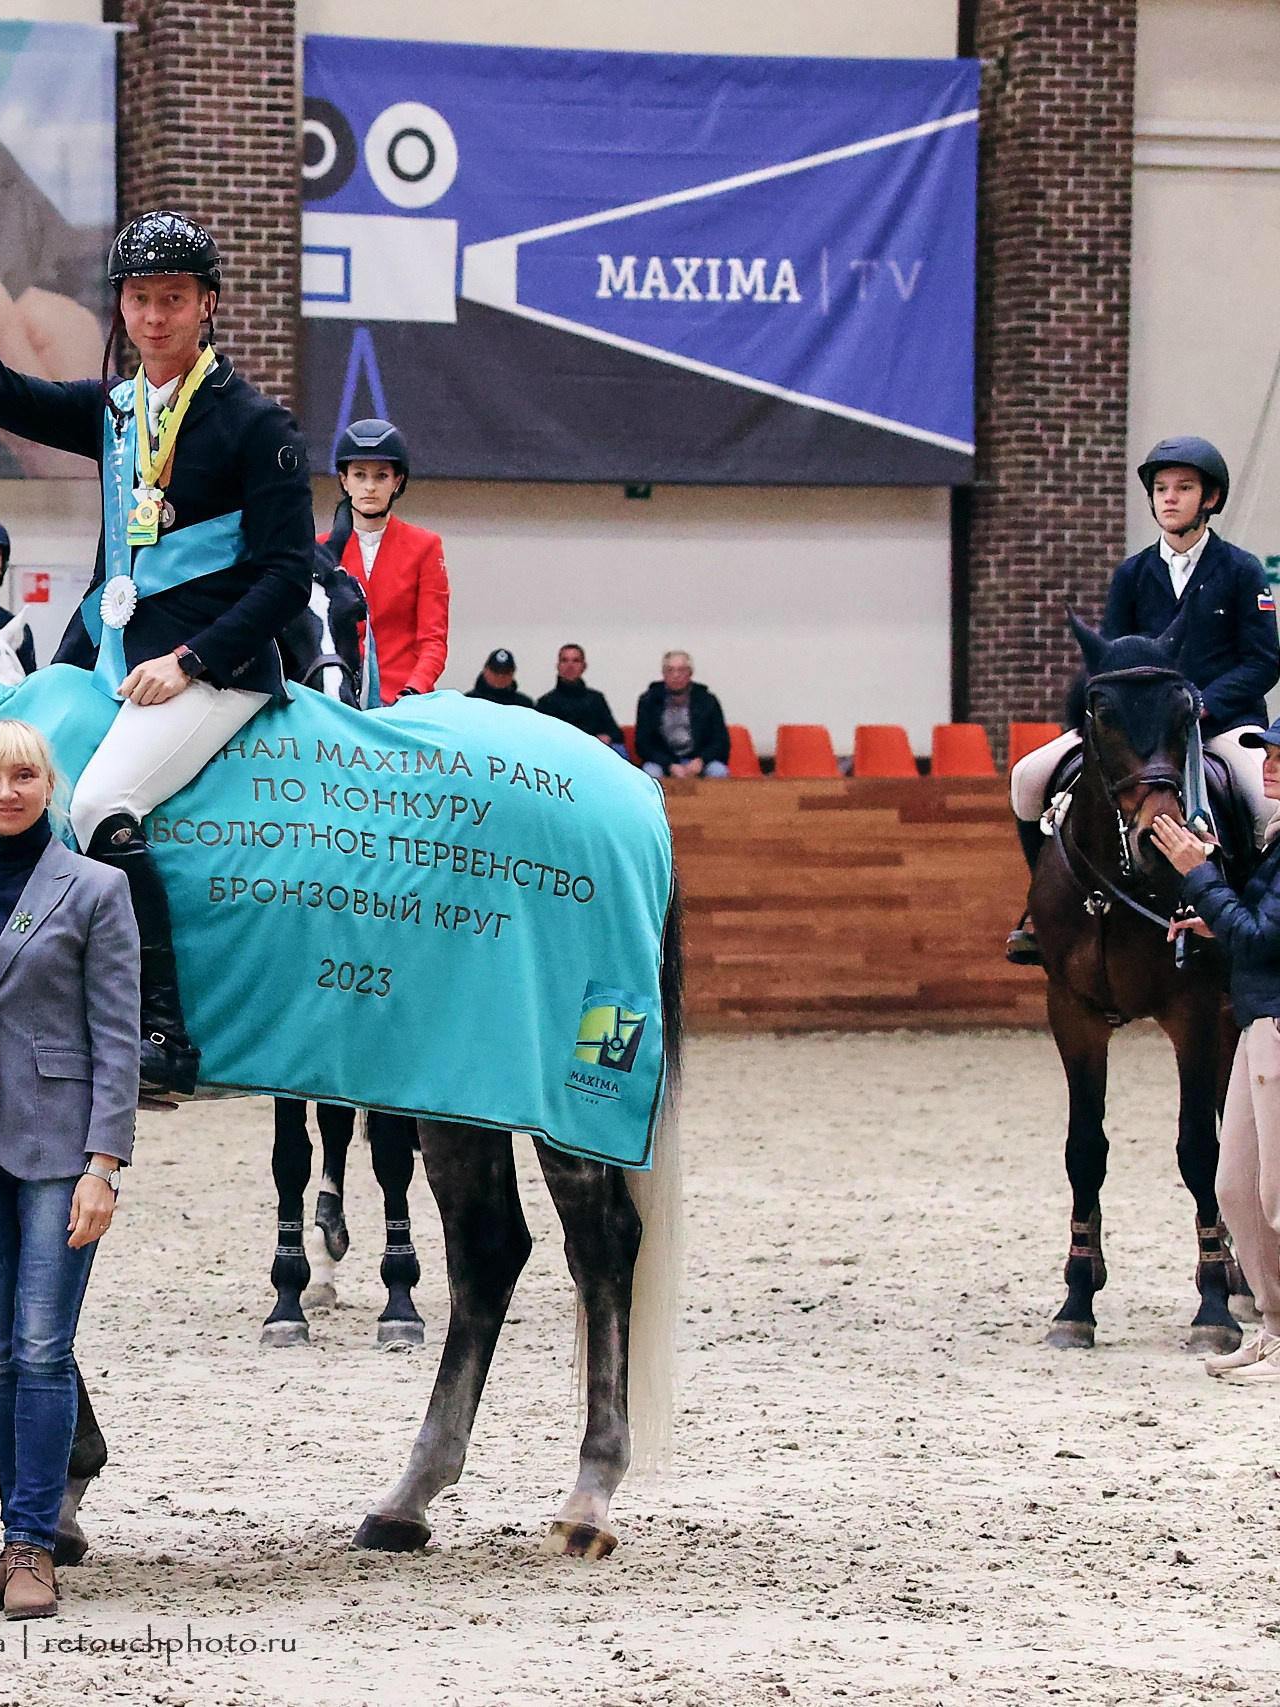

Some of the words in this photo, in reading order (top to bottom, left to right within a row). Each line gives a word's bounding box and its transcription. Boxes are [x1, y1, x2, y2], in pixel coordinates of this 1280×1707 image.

[595, 254, 802, 303] MAXIMA
[222, 738, 301, 760] НАЛ
[317, 740, 473, 778] MAXIMA
[488, 757, 575, 802] PARK
[253, 777, 306, 803] ПО
[322, 782, 492, 826] КОНКУРУ
[147, 817, 376, 860] БСОЛЮТНОЕ
[389, 837, 596, 903] ПЕРВЕНСТВО
[208, 876, 421, 925] БРОНЗОВЫЙ
[434, 902, 512, 938] КРУГ
[318, 959, 393, 997] 2023
[570, 1070, 619, 1093] MAXIMA
